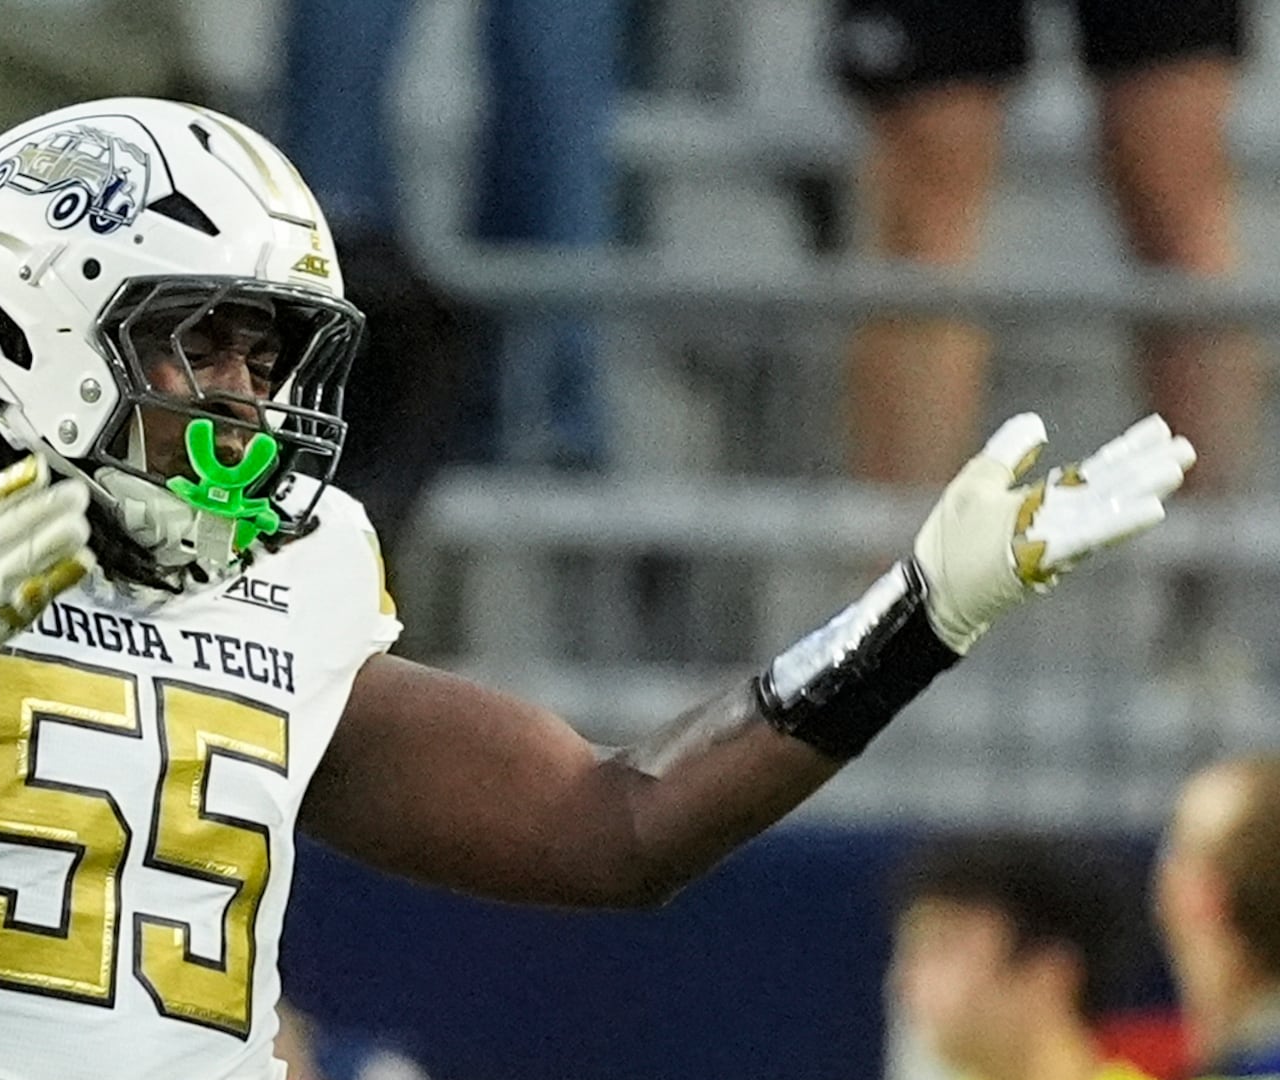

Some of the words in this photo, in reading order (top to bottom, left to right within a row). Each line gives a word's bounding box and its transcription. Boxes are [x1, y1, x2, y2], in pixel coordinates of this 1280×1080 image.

[290, 253, 329, 278] ACC
[223, 576, 290, 612] ACC
[180, 630, 295, 694] TECH
